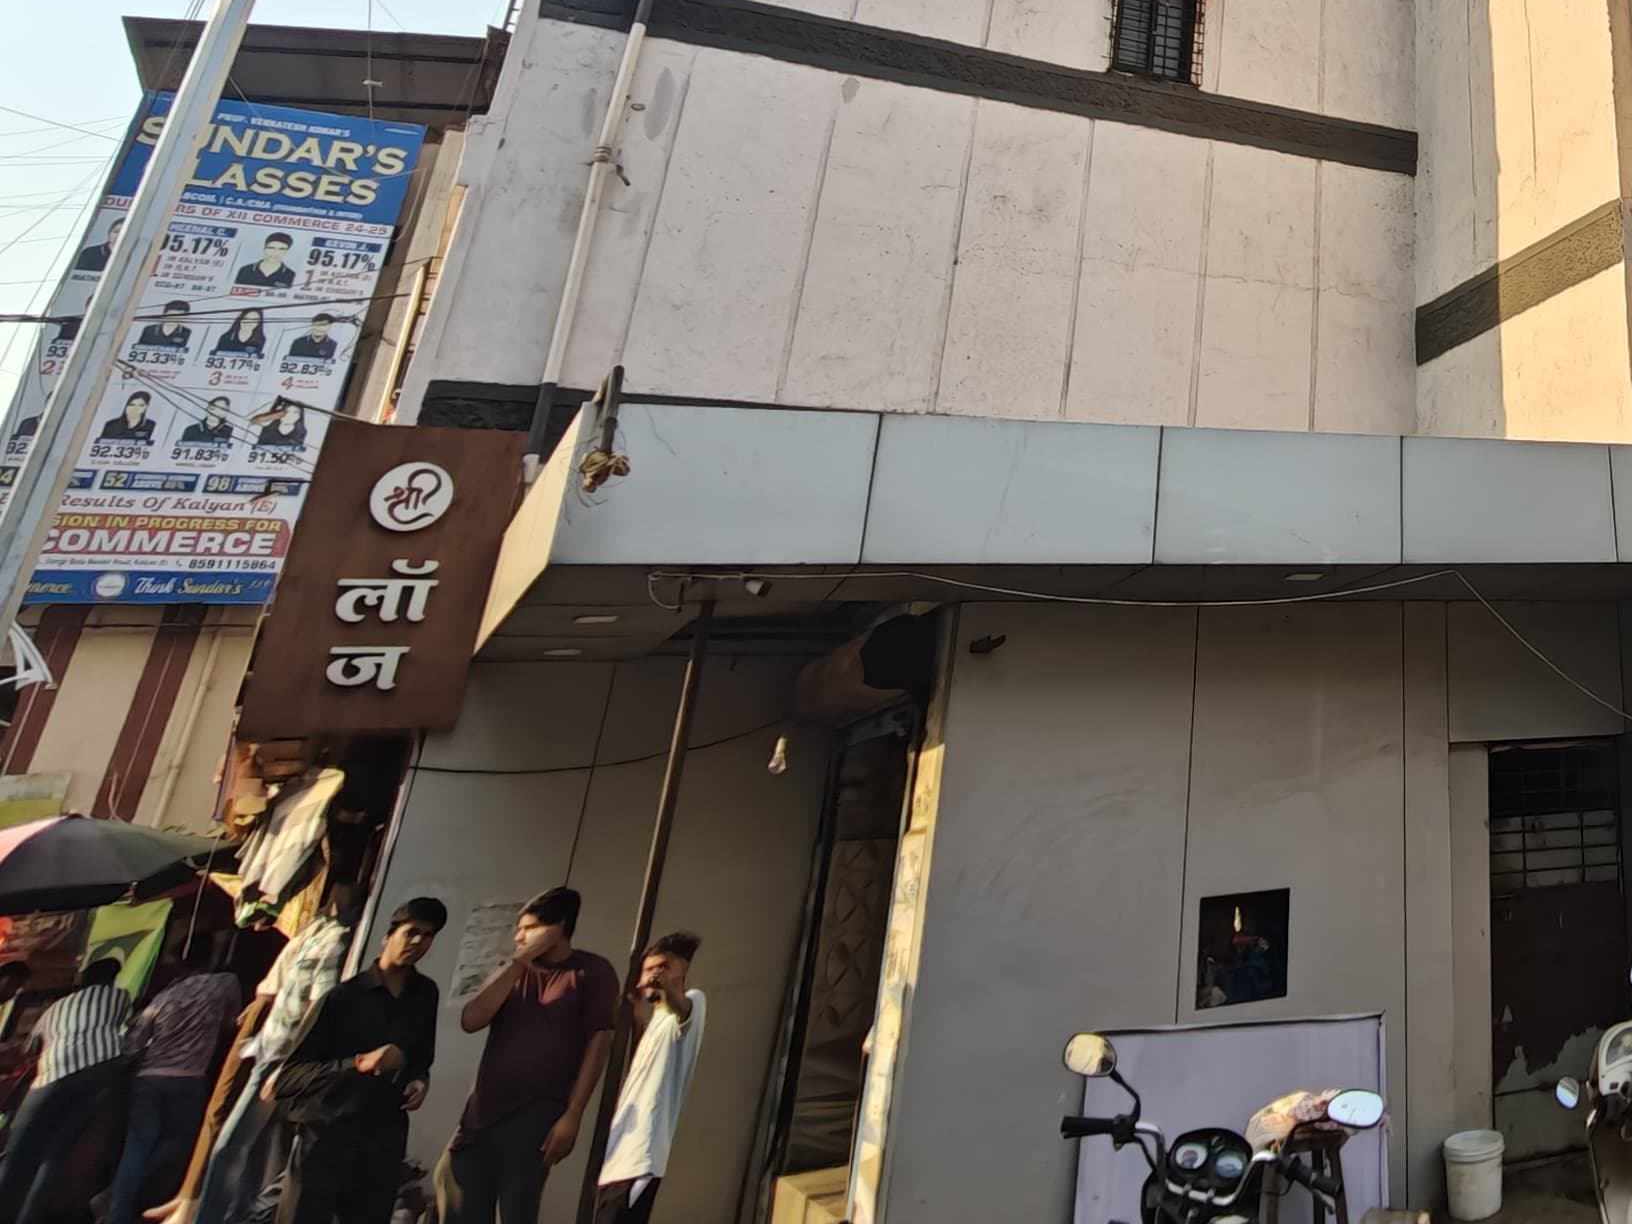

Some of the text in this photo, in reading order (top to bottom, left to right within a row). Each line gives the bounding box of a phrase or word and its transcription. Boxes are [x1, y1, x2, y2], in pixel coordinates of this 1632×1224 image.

[183, 159, 379, 207] LASSES
[253, 213, 340, 232] COMMERCE
[306, 248, 376, 272] 95.17%
[128, 351, 185, 366] 93.33%
[205, 357, 261, 372] 93.17%
[280, 362, 333, 377] 92.83%
[90, 444, 151, 460] 92.33%
[170, 448, 230, 462] 91.83%
[104, 470, 129, 488] 52
[207, 476, 232, 492] 98
[172, 495, 245, 514] Kalyan
[106, 516, 131, 529] IN
[137, 516, 240, 531] PROGRESS
[245, 519, 281, 532] FOR
[134, 577, 177, 595] Think
